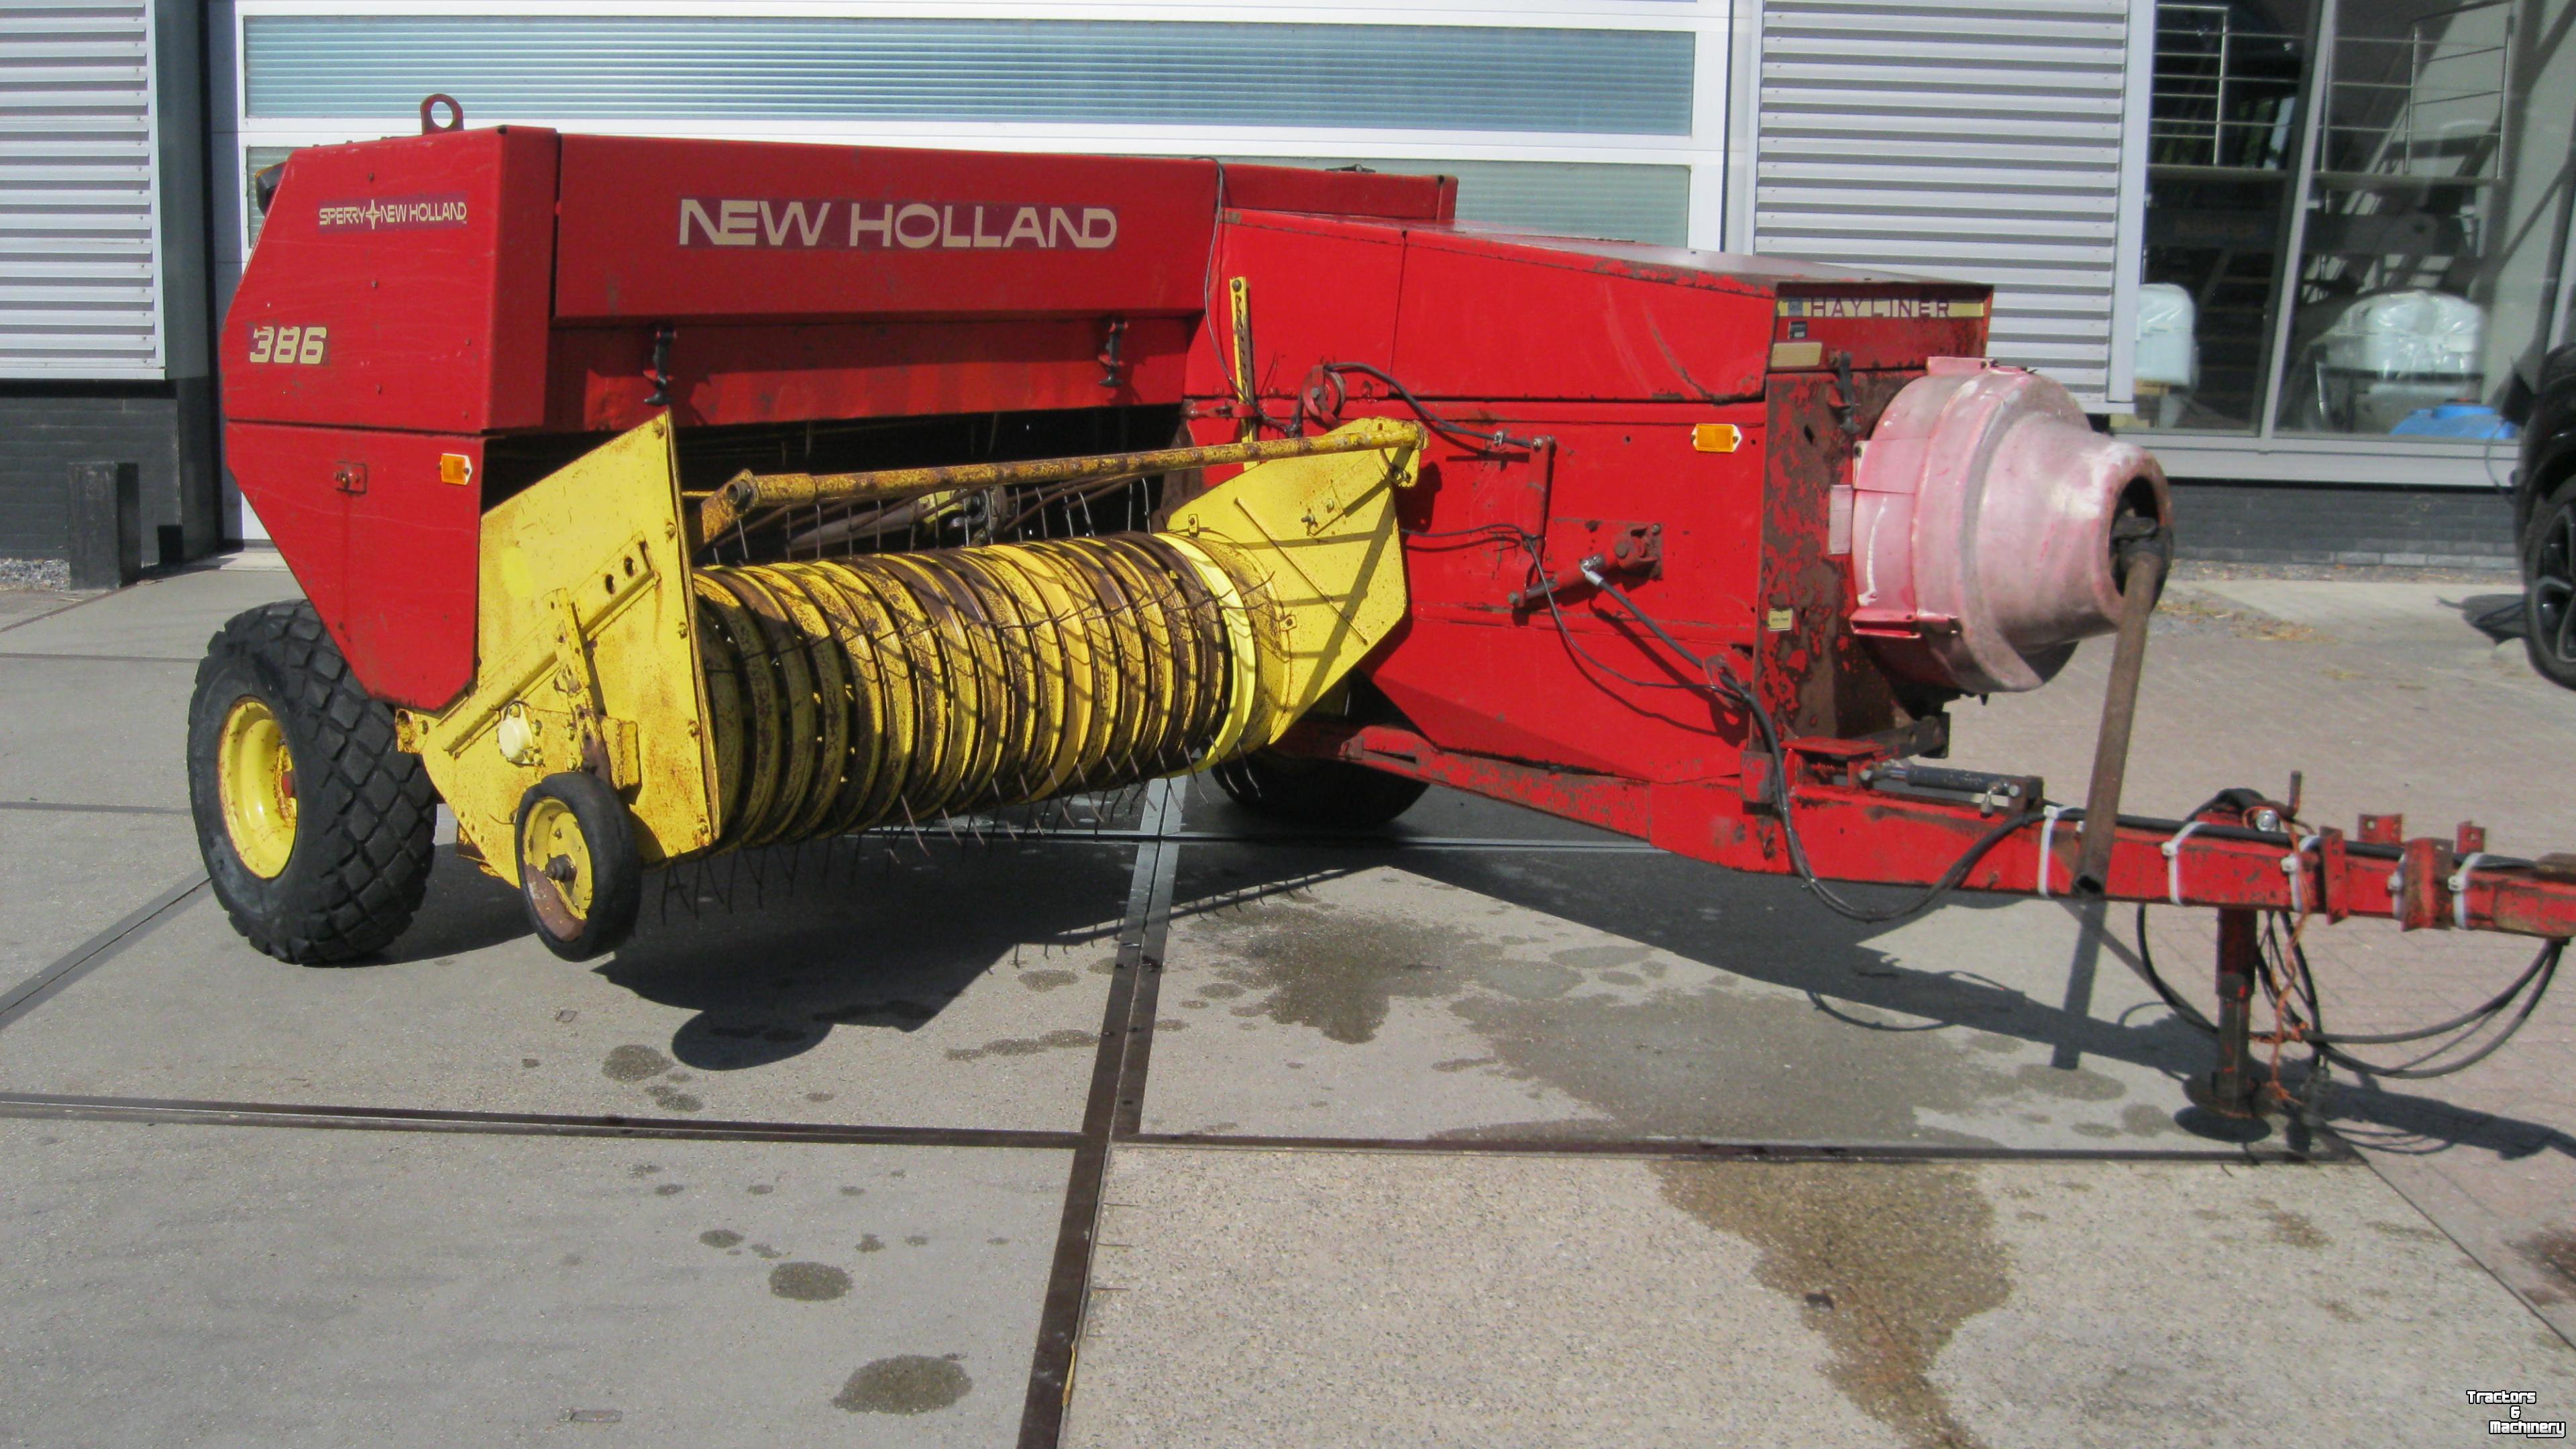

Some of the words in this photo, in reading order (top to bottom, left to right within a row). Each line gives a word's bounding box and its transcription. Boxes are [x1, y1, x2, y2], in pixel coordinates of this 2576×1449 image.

[319, 206, 365, 225] SPERRY
[380, 204, 407, 223] NEW
[409, 201, 467, 222] HOLLAND
[679, 199, 831, 246] NEW
[849, 203, 1117, 249] HOLLAND
[1811, 297, 1949, 318] HAYLINER
[250, 325, 327, 364] 386
